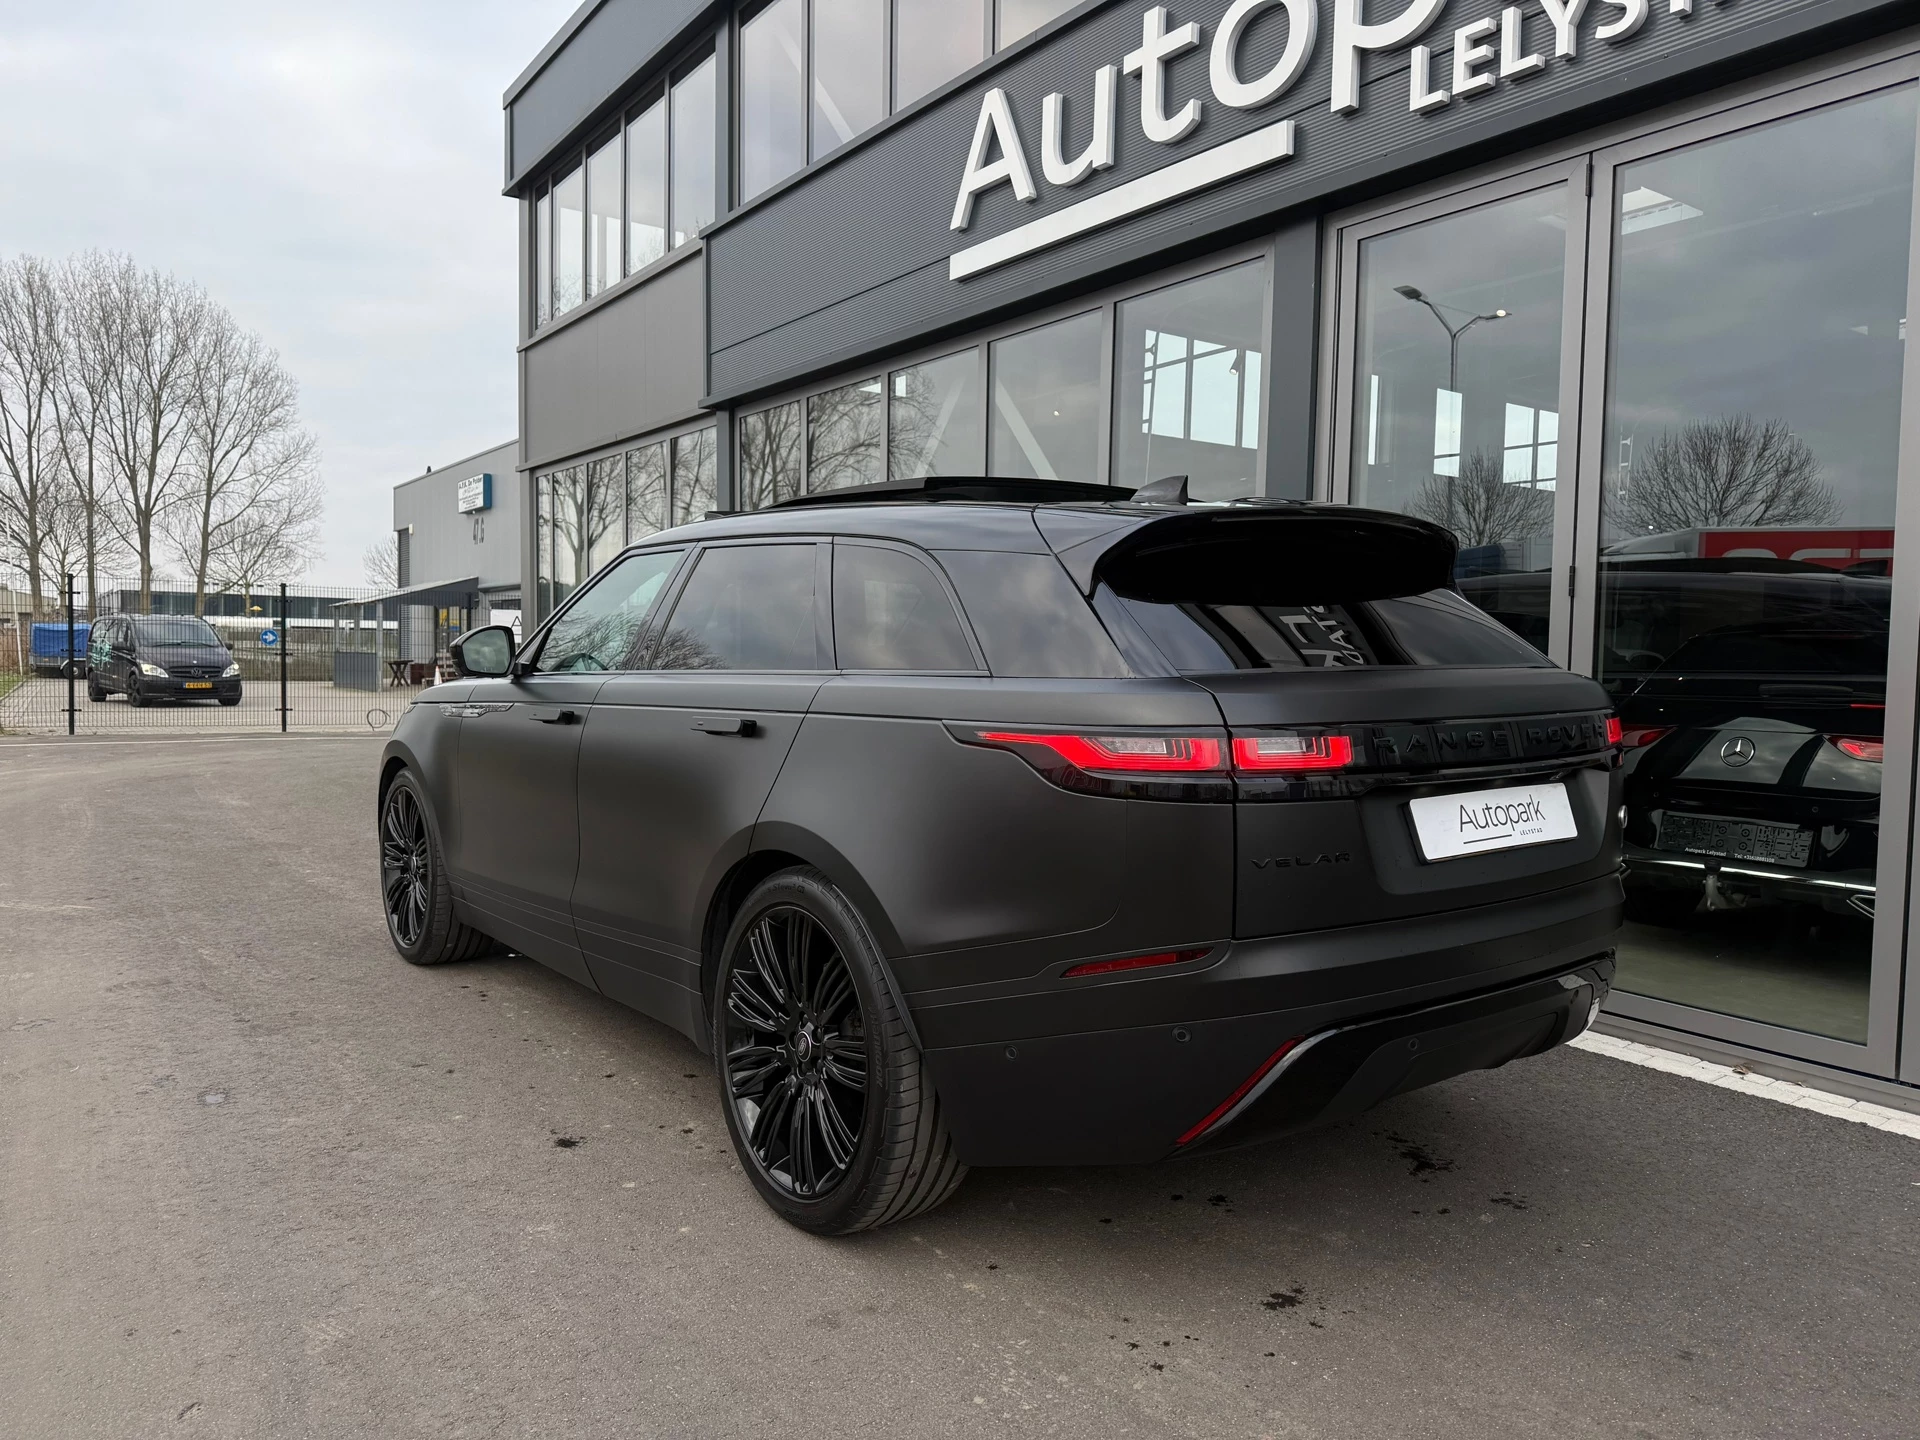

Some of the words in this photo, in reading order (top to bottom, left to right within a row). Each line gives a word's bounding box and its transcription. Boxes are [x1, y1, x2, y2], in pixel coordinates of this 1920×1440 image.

[1409, 0, 1693, 113] LELYS
[1372, 730, 1509, 753] RANGE
[1526, 723, 1604, 745] ROVER
[1460, 794, 1546, 832] Autopark
[1519, 828, 1543, 836] LELYSTAD
[1249, 852, 1350, 870] VELAR
